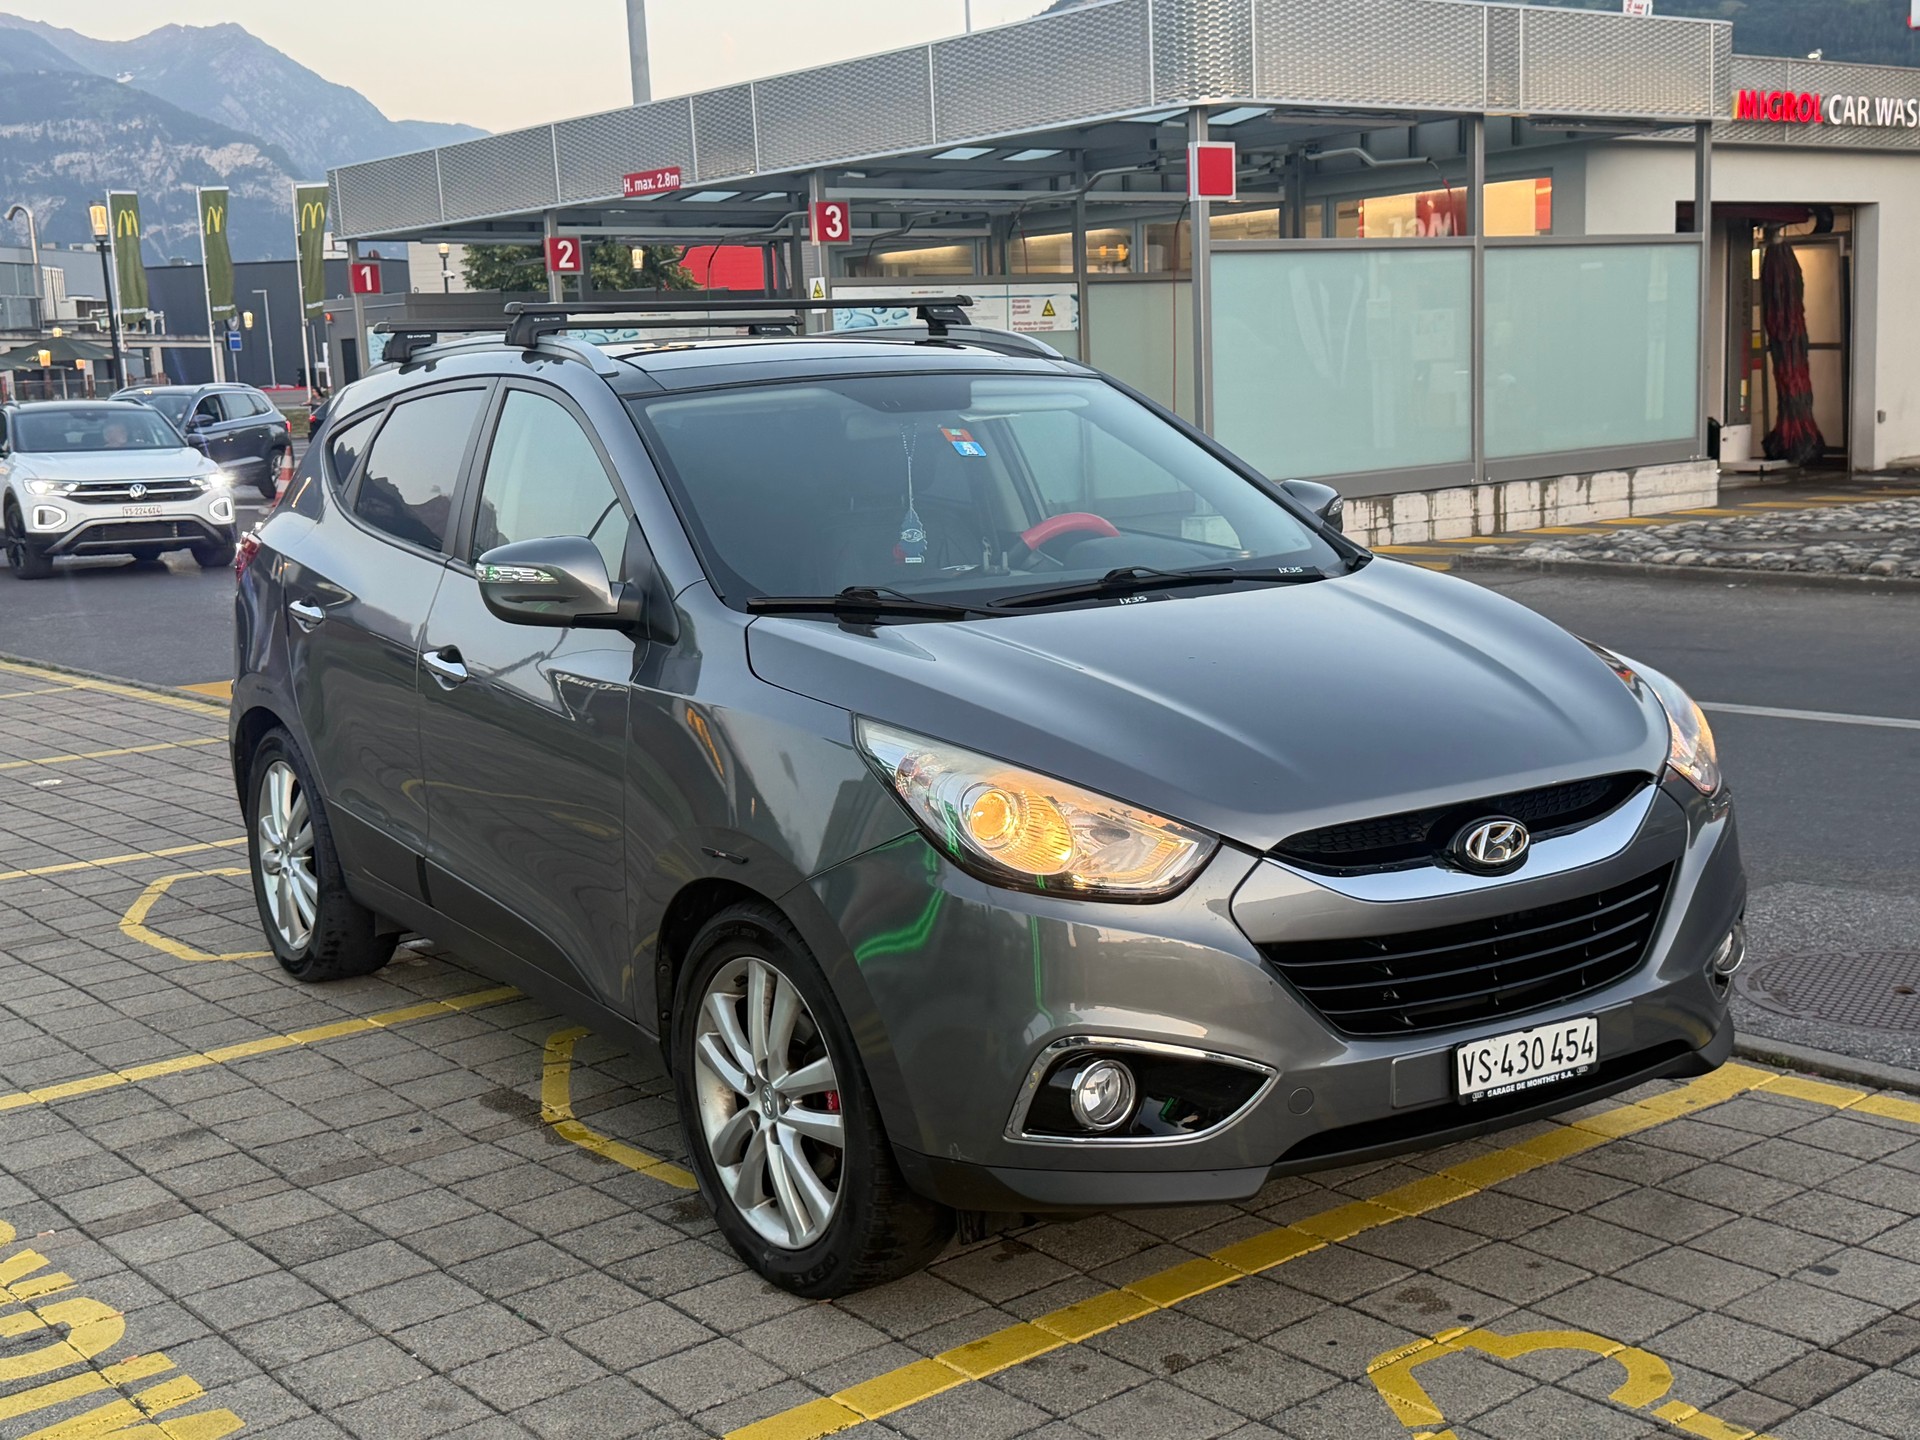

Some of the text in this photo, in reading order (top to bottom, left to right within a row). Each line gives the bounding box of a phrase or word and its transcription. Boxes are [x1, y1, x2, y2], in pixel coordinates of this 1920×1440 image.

[1738, 89, 1920, 128] MIGROL CAR WAS
[623, 172, 680, 193] H. max. 2.8m
[824, 204, 843, 239] 3
[557, 240, 575, 269] 2
[360, 266, 374, 291] 1
[1487, 1070, 1574, 1098] GARAGE DE MONTHEY S.A.
